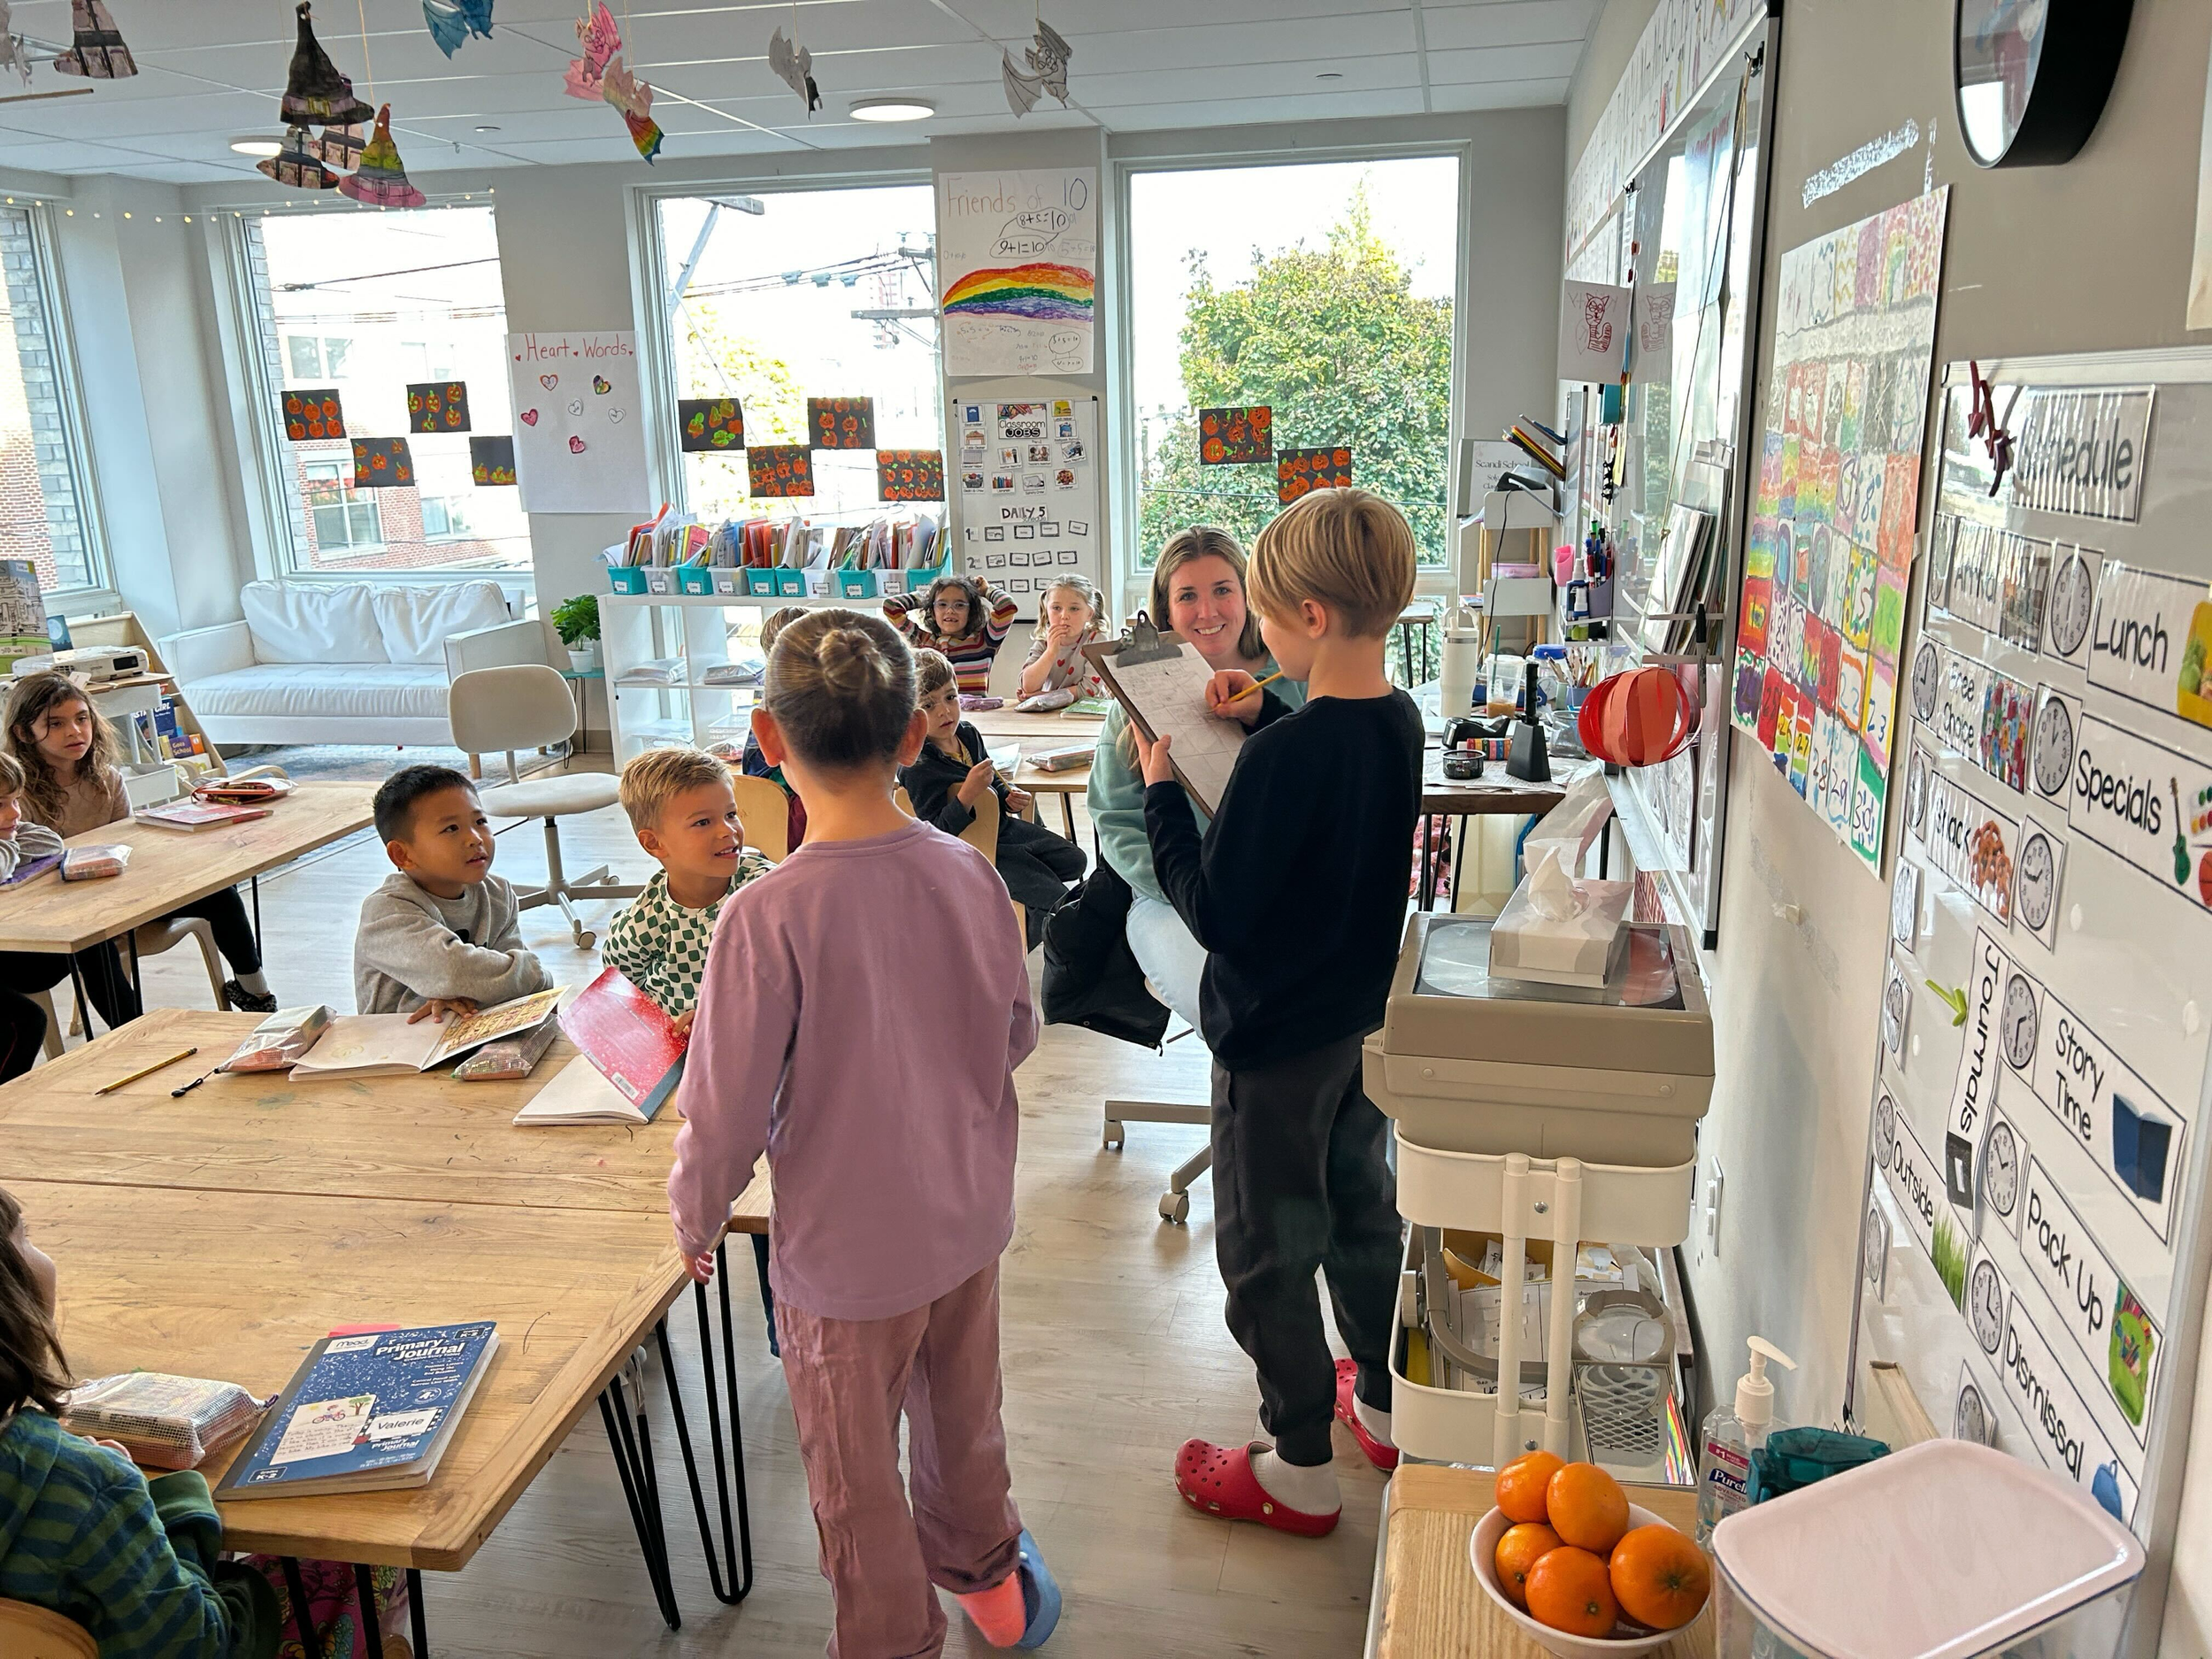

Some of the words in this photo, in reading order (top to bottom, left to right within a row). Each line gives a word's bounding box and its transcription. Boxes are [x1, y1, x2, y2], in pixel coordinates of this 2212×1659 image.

[947, 177, 1016, 218] Friends
[1027, 184, 1044, 209] of
[1064, 178, 1087, 211] 10
[525, 334, 570, 361] Heart
[583, 334, 627, 358] Words
[999, 420, 1046, 429] Classroom
[1005, 428, 1041, 437] JOBS
[1002, 507, 1035, 519] DAILY
[1039, 506, 1046, 518] 5
[2093, 597, 2169, 673] Lunch
[1840, 672, 1859, 716] 22
[1778, 713, 1793, 748] 26
[1867, 699, 1886, 742] 23
[1797, 733, 1809, 757] 27
[1814, 748, 1828, 791] 28
[1831, 768, 1848, 816] 29
[1853, 791, 1871, 833] 30
[2076, 749, 2162, 836] Specials
[1960, 944, 2001, 1133] Journals
[2055, 1018, 2105, 1103] Story
[2055, 1069, 2092, 1141] Time
[1893, 1140, 1933, 1227] Outside
[2027, 1188, 2071, 1288] Pack
[2077, 1259, 2103, 1335] Up
[375, 1339, 443, 1356] Primary
[394, 1342, 465, 1361] Journal
[378, 1417, 425, 1430] Valerie
[2006, 1324, 2085, 1482] Dismissal
[371, 1437, 408, 1448] Primary
[380, 1440, 419, 1451] Journal
[256, 1472, 277, 1481] K-2
